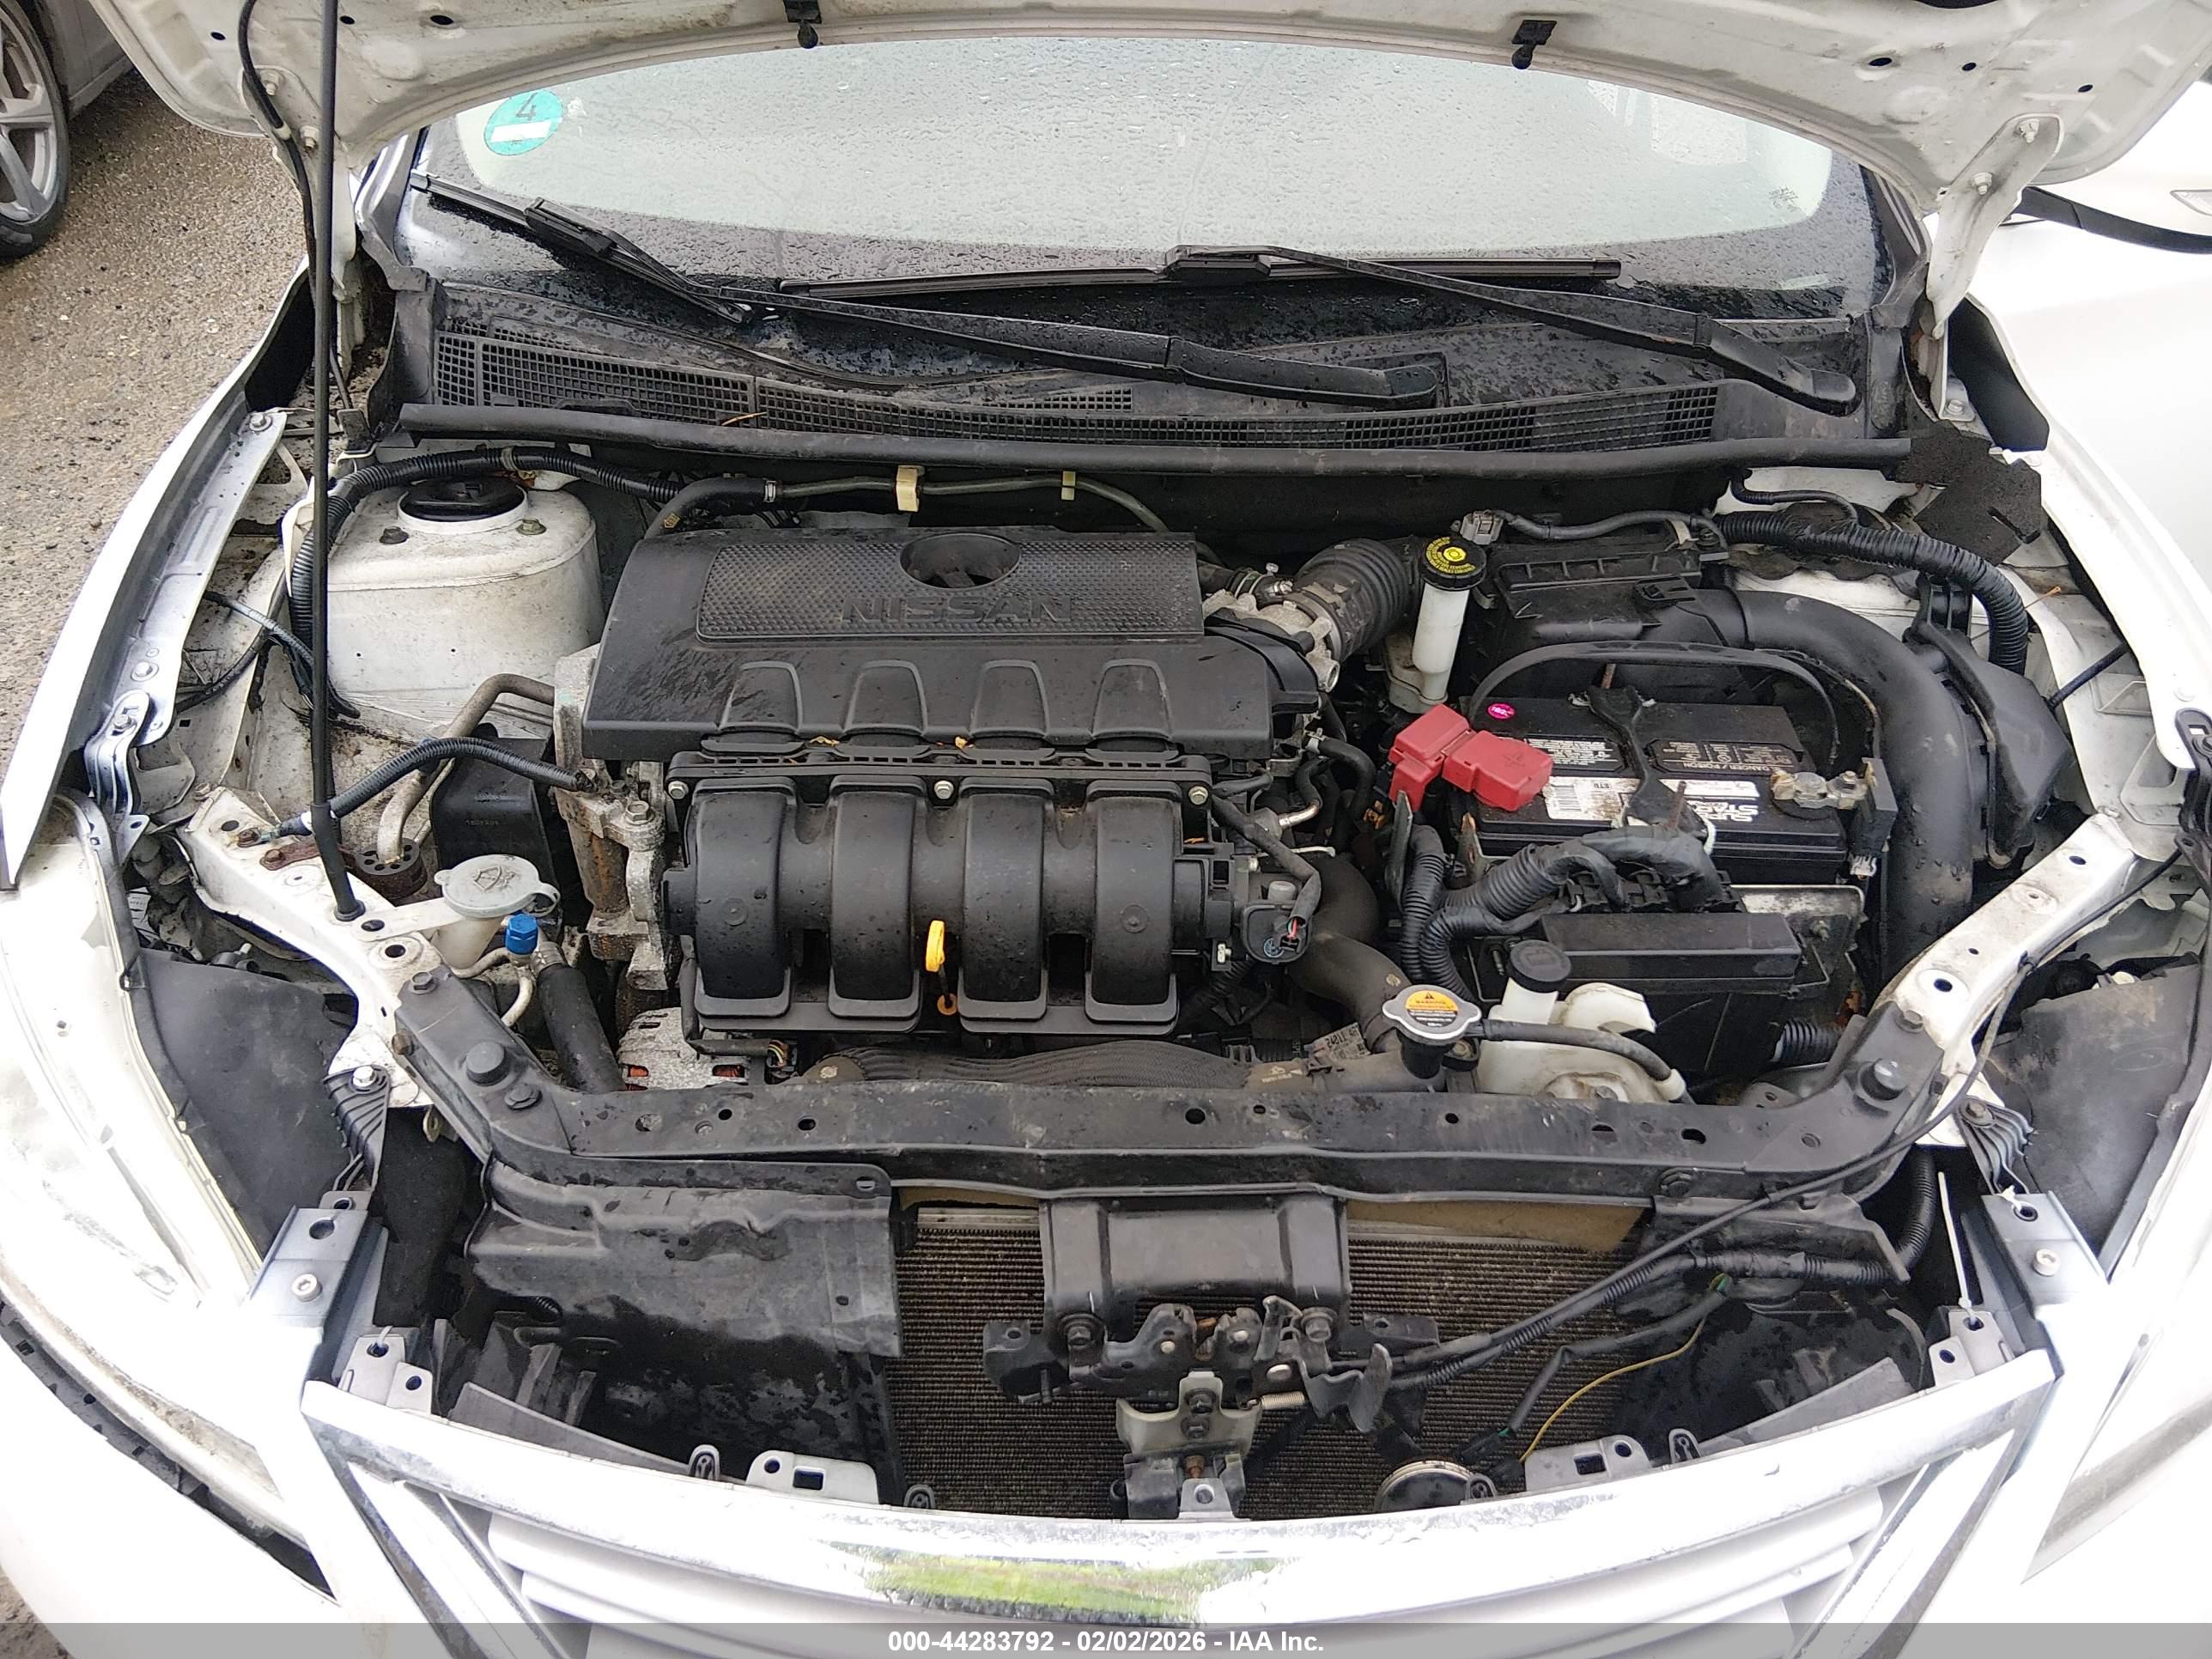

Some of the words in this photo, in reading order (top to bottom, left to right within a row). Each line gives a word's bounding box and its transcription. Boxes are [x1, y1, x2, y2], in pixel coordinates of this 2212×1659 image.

[514, 91, 538, 120] 4
[840, 596, 1073, 624] NISSAN
[1683, 762, 1721, 770] POISON
[1696, 811, 1753, 823] SUPE
